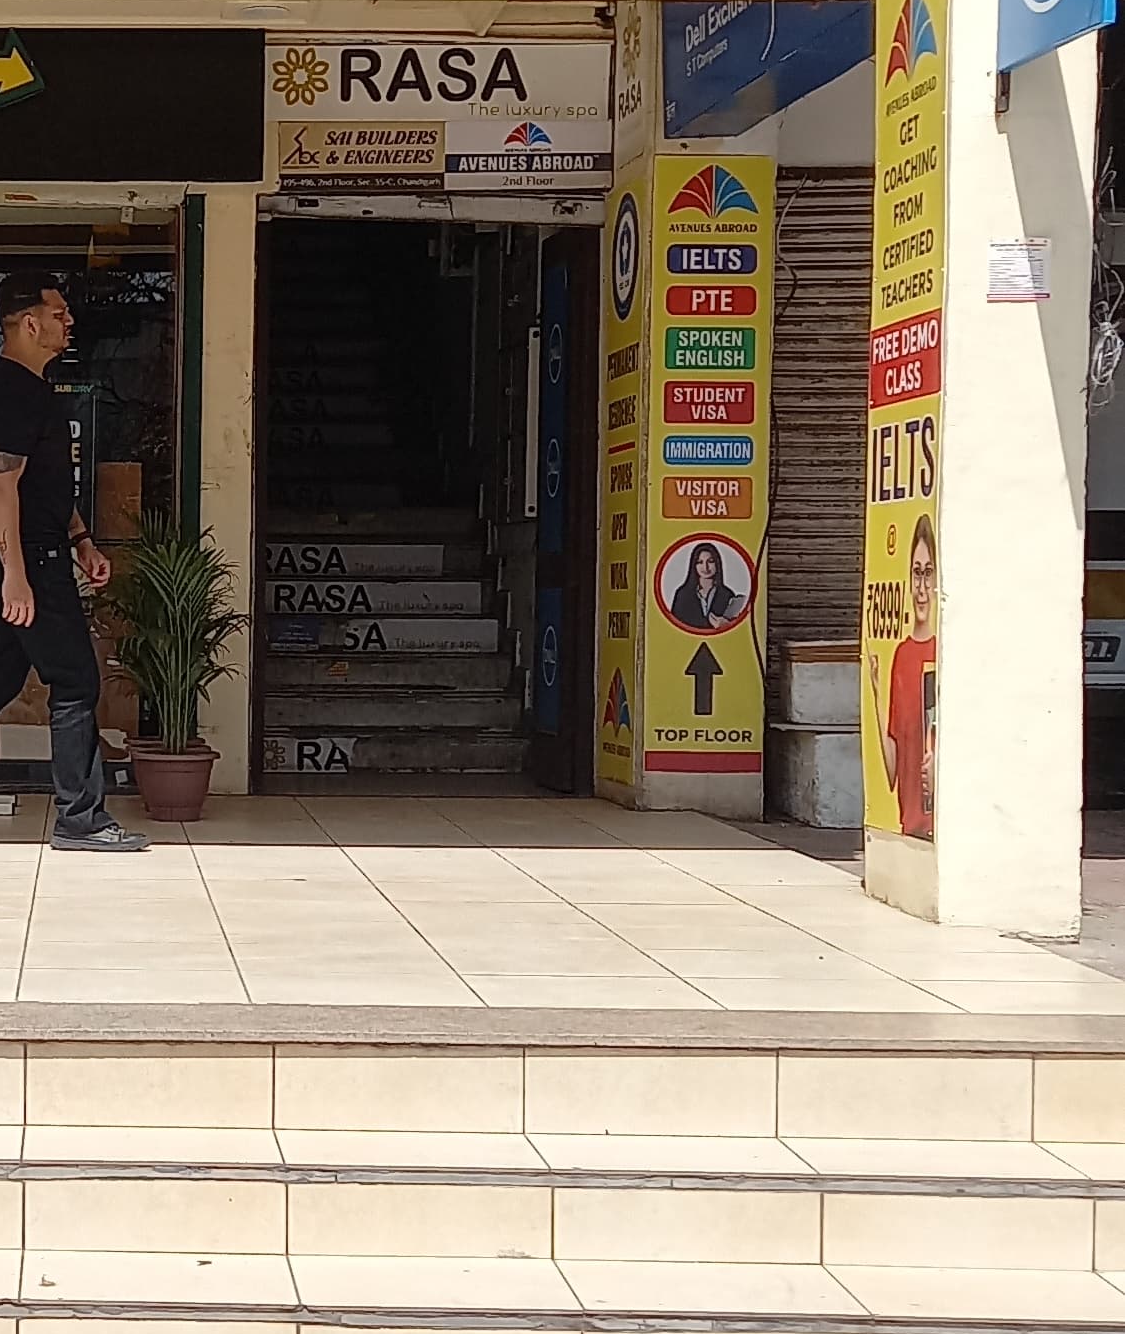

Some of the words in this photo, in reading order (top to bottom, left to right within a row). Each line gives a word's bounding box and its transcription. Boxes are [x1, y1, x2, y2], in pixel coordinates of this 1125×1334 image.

[684, 14, 707, 53] Dell
[339, 47, 529, 103] RASA
[468, 102, 502, 117] The
[506, 102, 561, 117] luxury
[566, 105, 598, 118] spa
[618, 79, 642, 121] RASA
[324, 130, 355, 147] SAI
[355, 129, 438, 146] BUILDERS
[899, 113, 920, 147] GET
[324, 150, 340, 166] &
[343, 149, 435, 166] ENGINEERS
[458, 155, 527, 171] AVENUES
[531, 155, 595, 171] ABROAD
[502, 175, 523, 186] 2nd
[526, 175, 555, 186] Floor
[883, 145, 938, 195] COACHING
[893, 191, 924, 229] FROM
[668, 223, 712, 233] AVENUES
[714, 223, 758, 233] ABROAD
[681, 247, 743, 272] IELTS
[882, 228, 935, 271] CERTIFIED
[880, 266, 934, 311] TEACHERS
[690, 288, 733, 313] PTE
[677, 330, 743, 348] SPOKEN
[872, 330, 895, 366] FREE
[896, 321, 939, 359] DEMO
[675, 349, 745, 367] ENGLISH
[884, 358, 922, 397] CLASS
[673, 387, 746, 404] STUDENT
[690, 404, 728, 421] VISA
[665, 440, 752, 460] IMMIGRATION
[869, 414, 936, 506] IELTS
[675, 479, 740, 497] VISITOR
[690, 498, 728, 516] VISA
[274, 583, 373, 614] RASA
[655, 728, 689, 742] TOP
[694, 729, 753, 744] FLOOR
